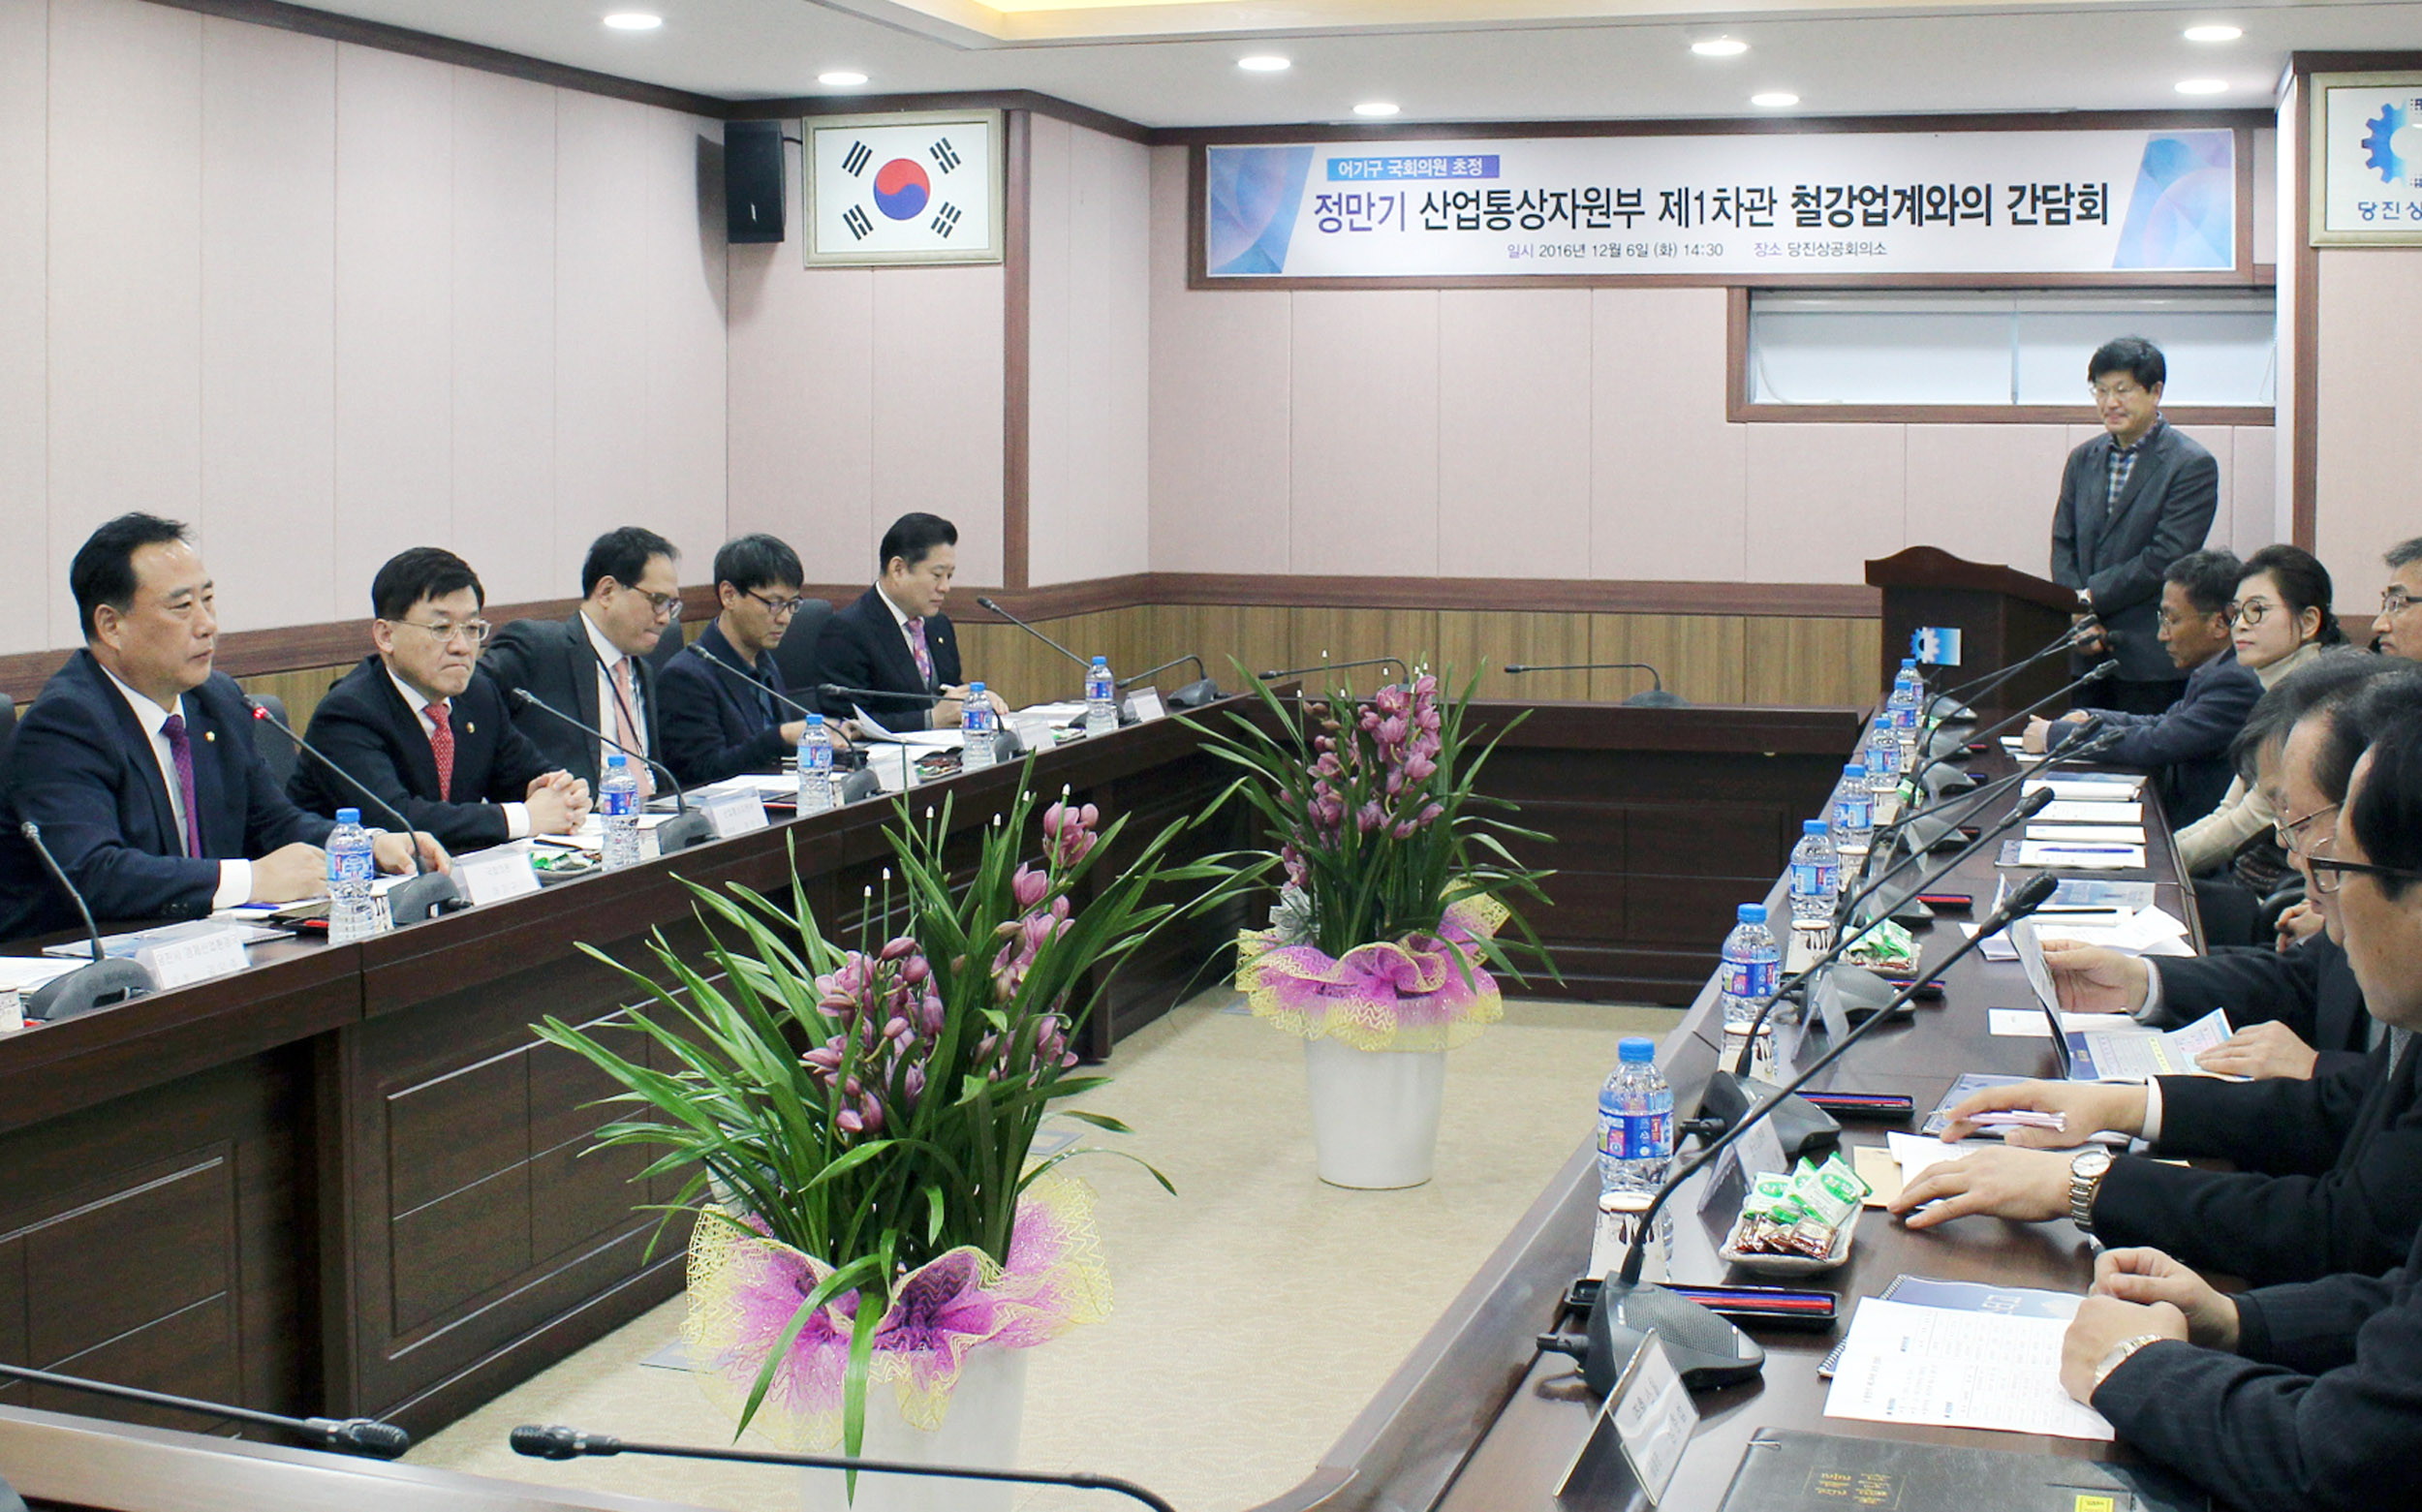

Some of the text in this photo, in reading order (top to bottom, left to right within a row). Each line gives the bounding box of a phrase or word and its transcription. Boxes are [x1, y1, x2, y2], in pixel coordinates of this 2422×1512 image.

[1338, 160, 1383, 177] 어기구
[1387, 158, 1447, 177] 국회의원
[1314, 181, 2109, 233] 정만기 산업통상자원부 제1차관 철강업계와의 간담회
[1506, 241, 1888, 260] 일시 2016년 12월 6일 (화) 14:30 장소 당진상공회의소
